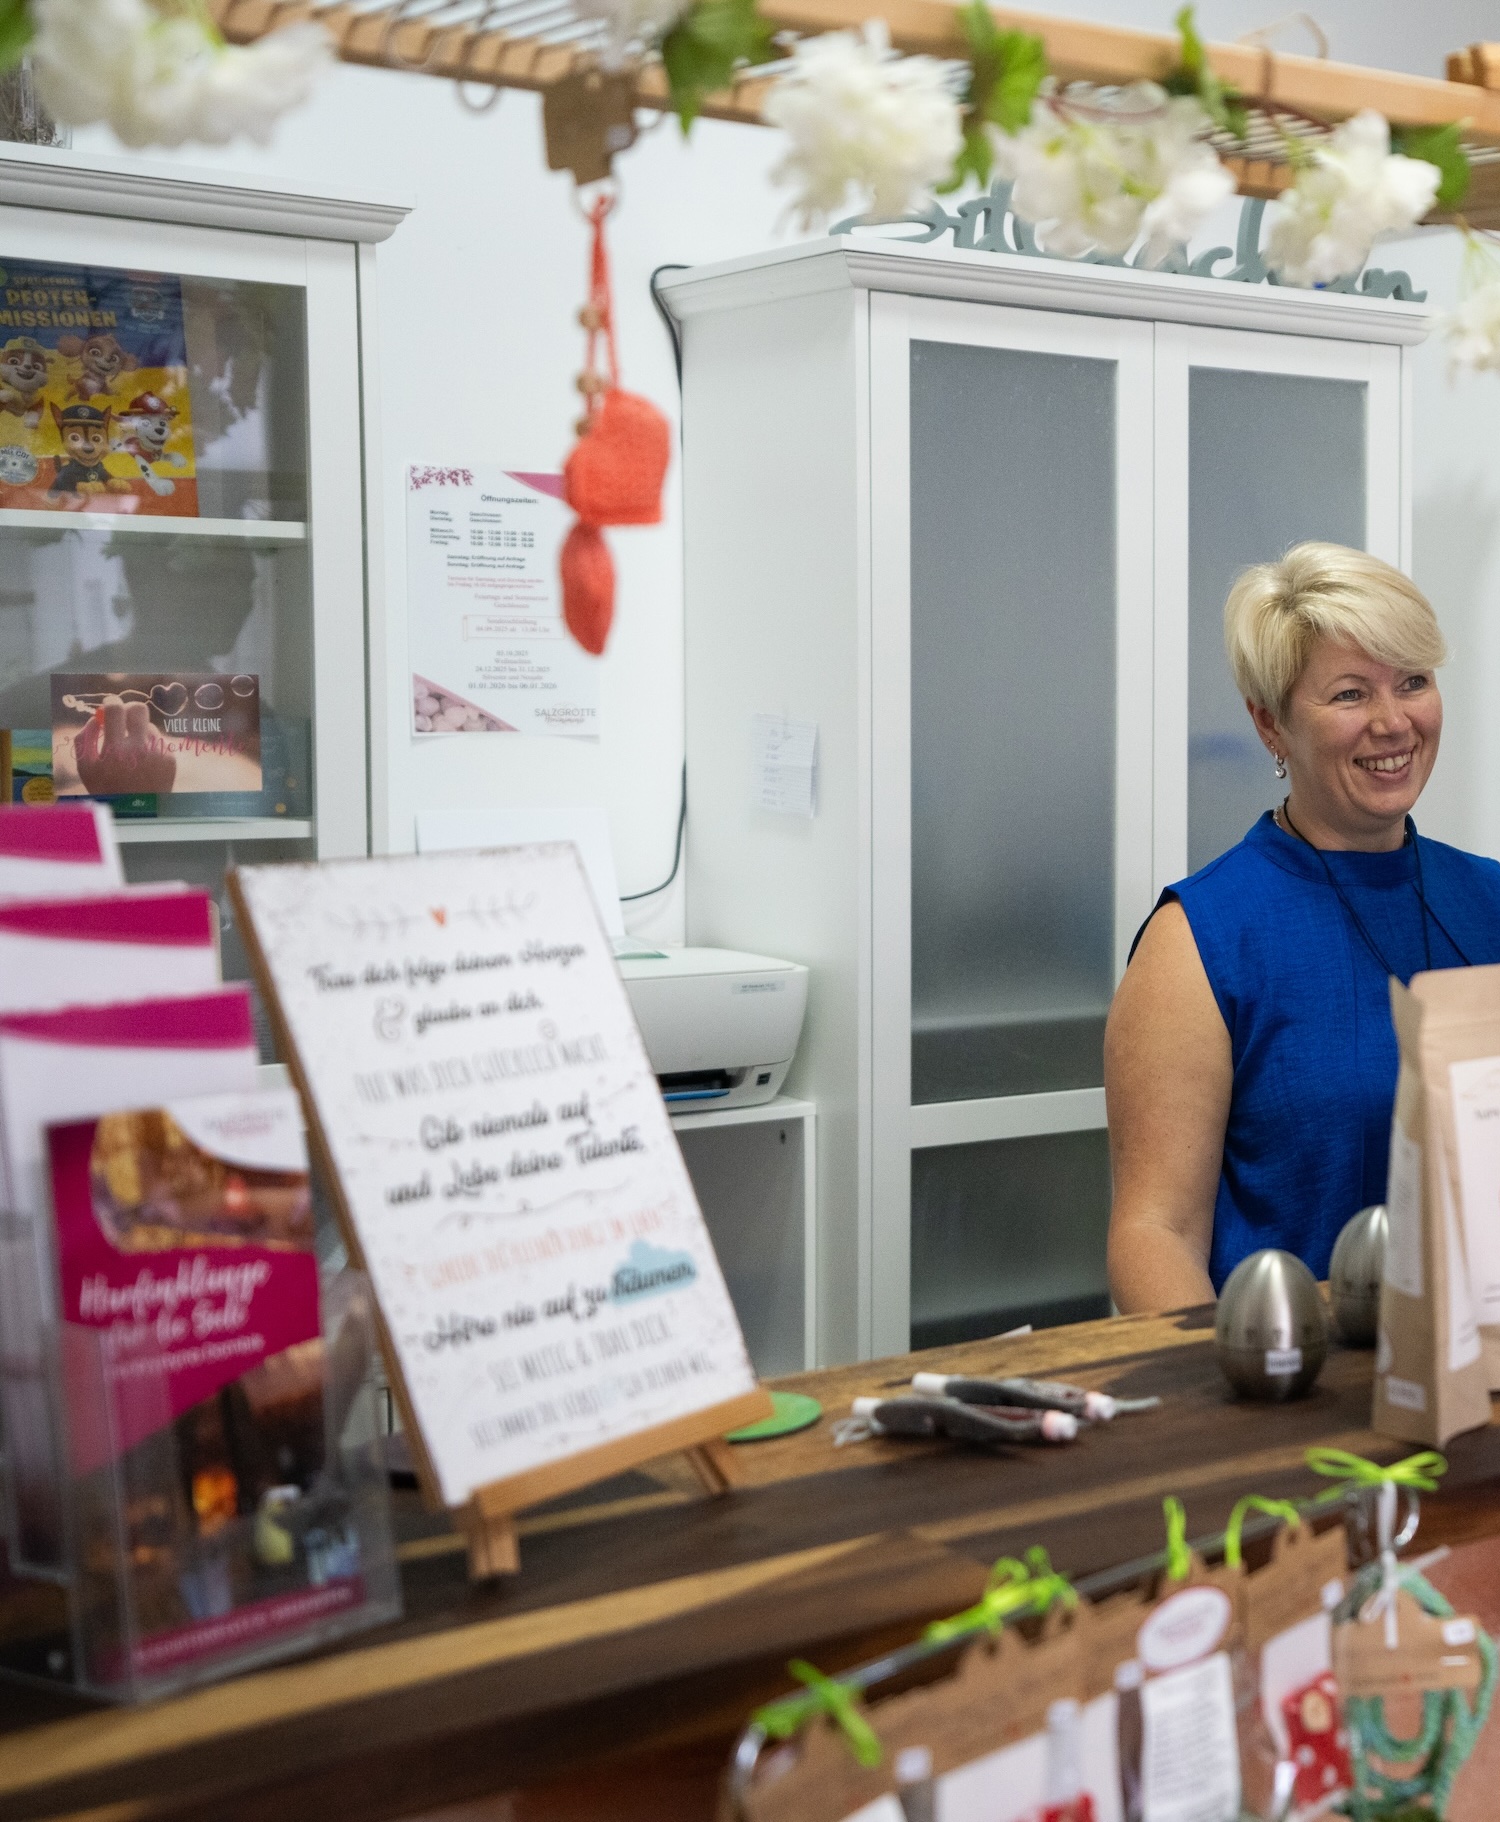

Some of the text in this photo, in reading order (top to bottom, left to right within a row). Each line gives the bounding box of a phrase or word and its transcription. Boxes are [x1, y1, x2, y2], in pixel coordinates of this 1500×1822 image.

[6, 288, 97, 307] PFOTEN-
[0, 309, 117, 327] MISSIONEN
[534, 708, 597, 717] SALZGROTTE
[164, 718, 222, 733] VIELE KLEINE
